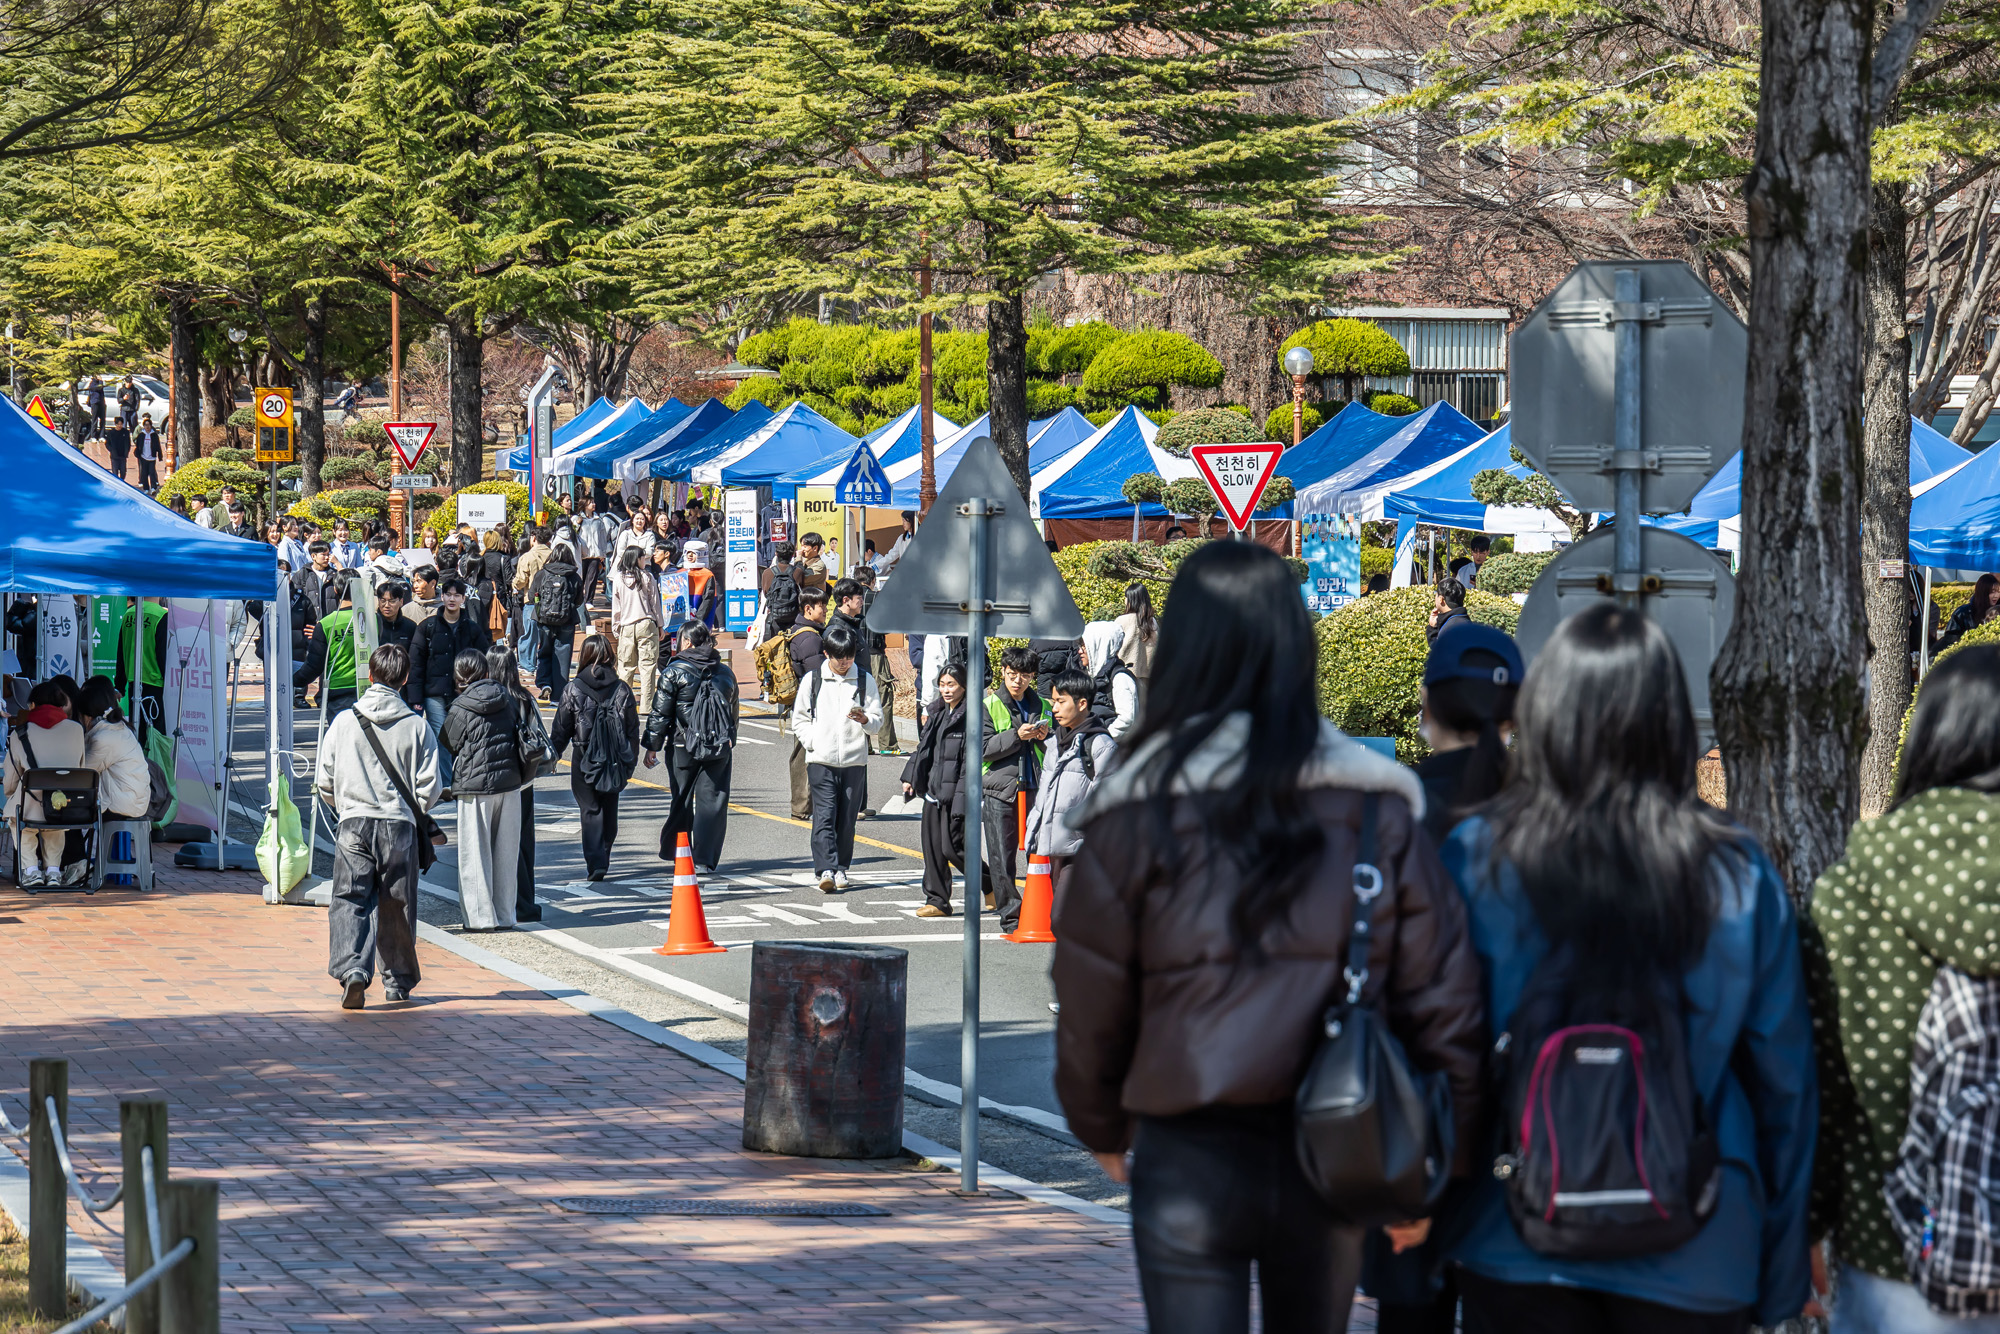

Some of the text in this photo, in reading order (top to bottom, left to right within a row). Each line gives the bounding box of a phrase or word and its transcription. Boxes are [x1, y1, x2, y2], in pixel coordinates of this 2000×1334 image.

[266, 400, 283, 412] 20
[538, 409, 546, 430] CCTV
[397, 428, 423, 438] 천천히
[400, 438, 420, 446] SLOW
[1215, 455, 1259, 471] 천천히
[1222, 473, 1254, 486] SLOW
[844, 494, 884, 503] 횡단보도
[804, 500, 838, 513] ROTC
[728, 516, 742, 526] 러닝
[728, 527, 755, 538] 프론티어
[1316, 577, 1347, 592] 와라!
[125, 615, 151, 629] 상수
